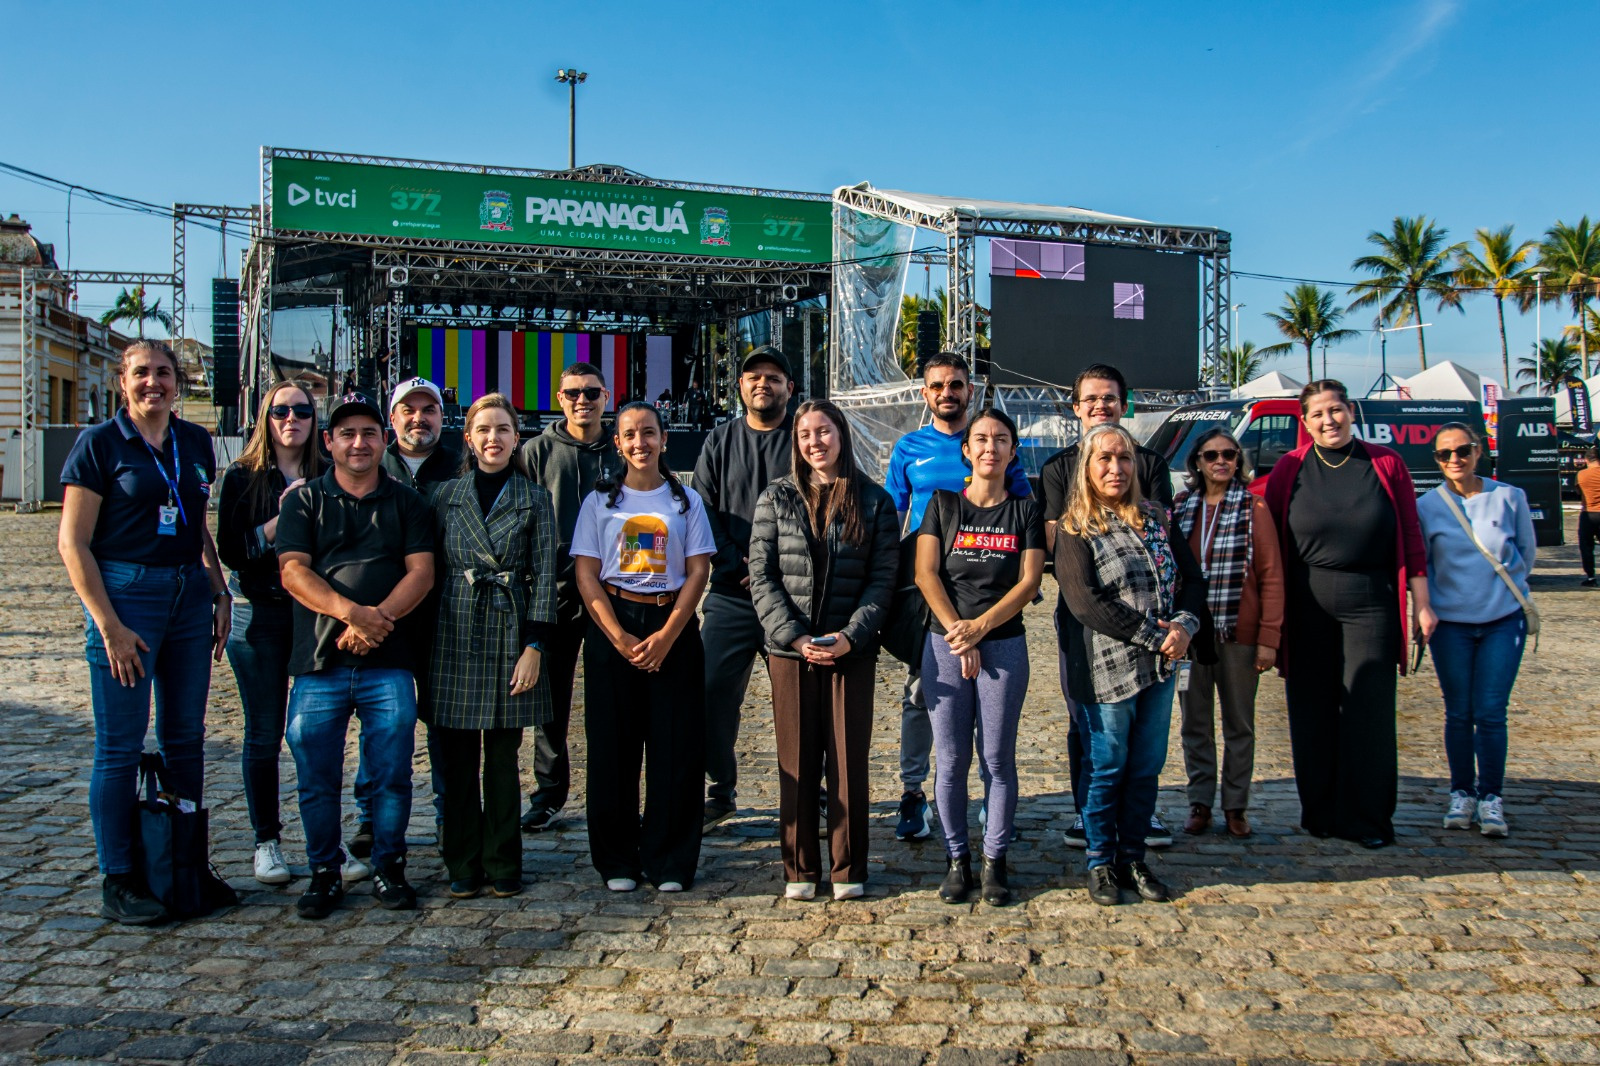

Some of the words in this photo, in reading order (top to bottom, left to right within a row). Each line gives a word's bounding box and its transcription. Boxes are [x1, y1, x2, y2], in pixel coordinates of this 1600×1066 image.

[315, 188, 356, 208] tvci
[565, 189, 635, 199] PREFEITURA
[391, 191, 441, 216] 372
[526, 197, 689, 234] PARANAGUÁ
[569, 231, 606, 240] CIDADE
[613, 234, 637, 242] PARA
[644, 236, 676, 245] TODOS
[985, 526, 1005, 534] NADA
[957, 535, 1017, 549] PSSIVEL
[951, 547, 976, 557] Para
[980, 549, 1007, 559] Deus
